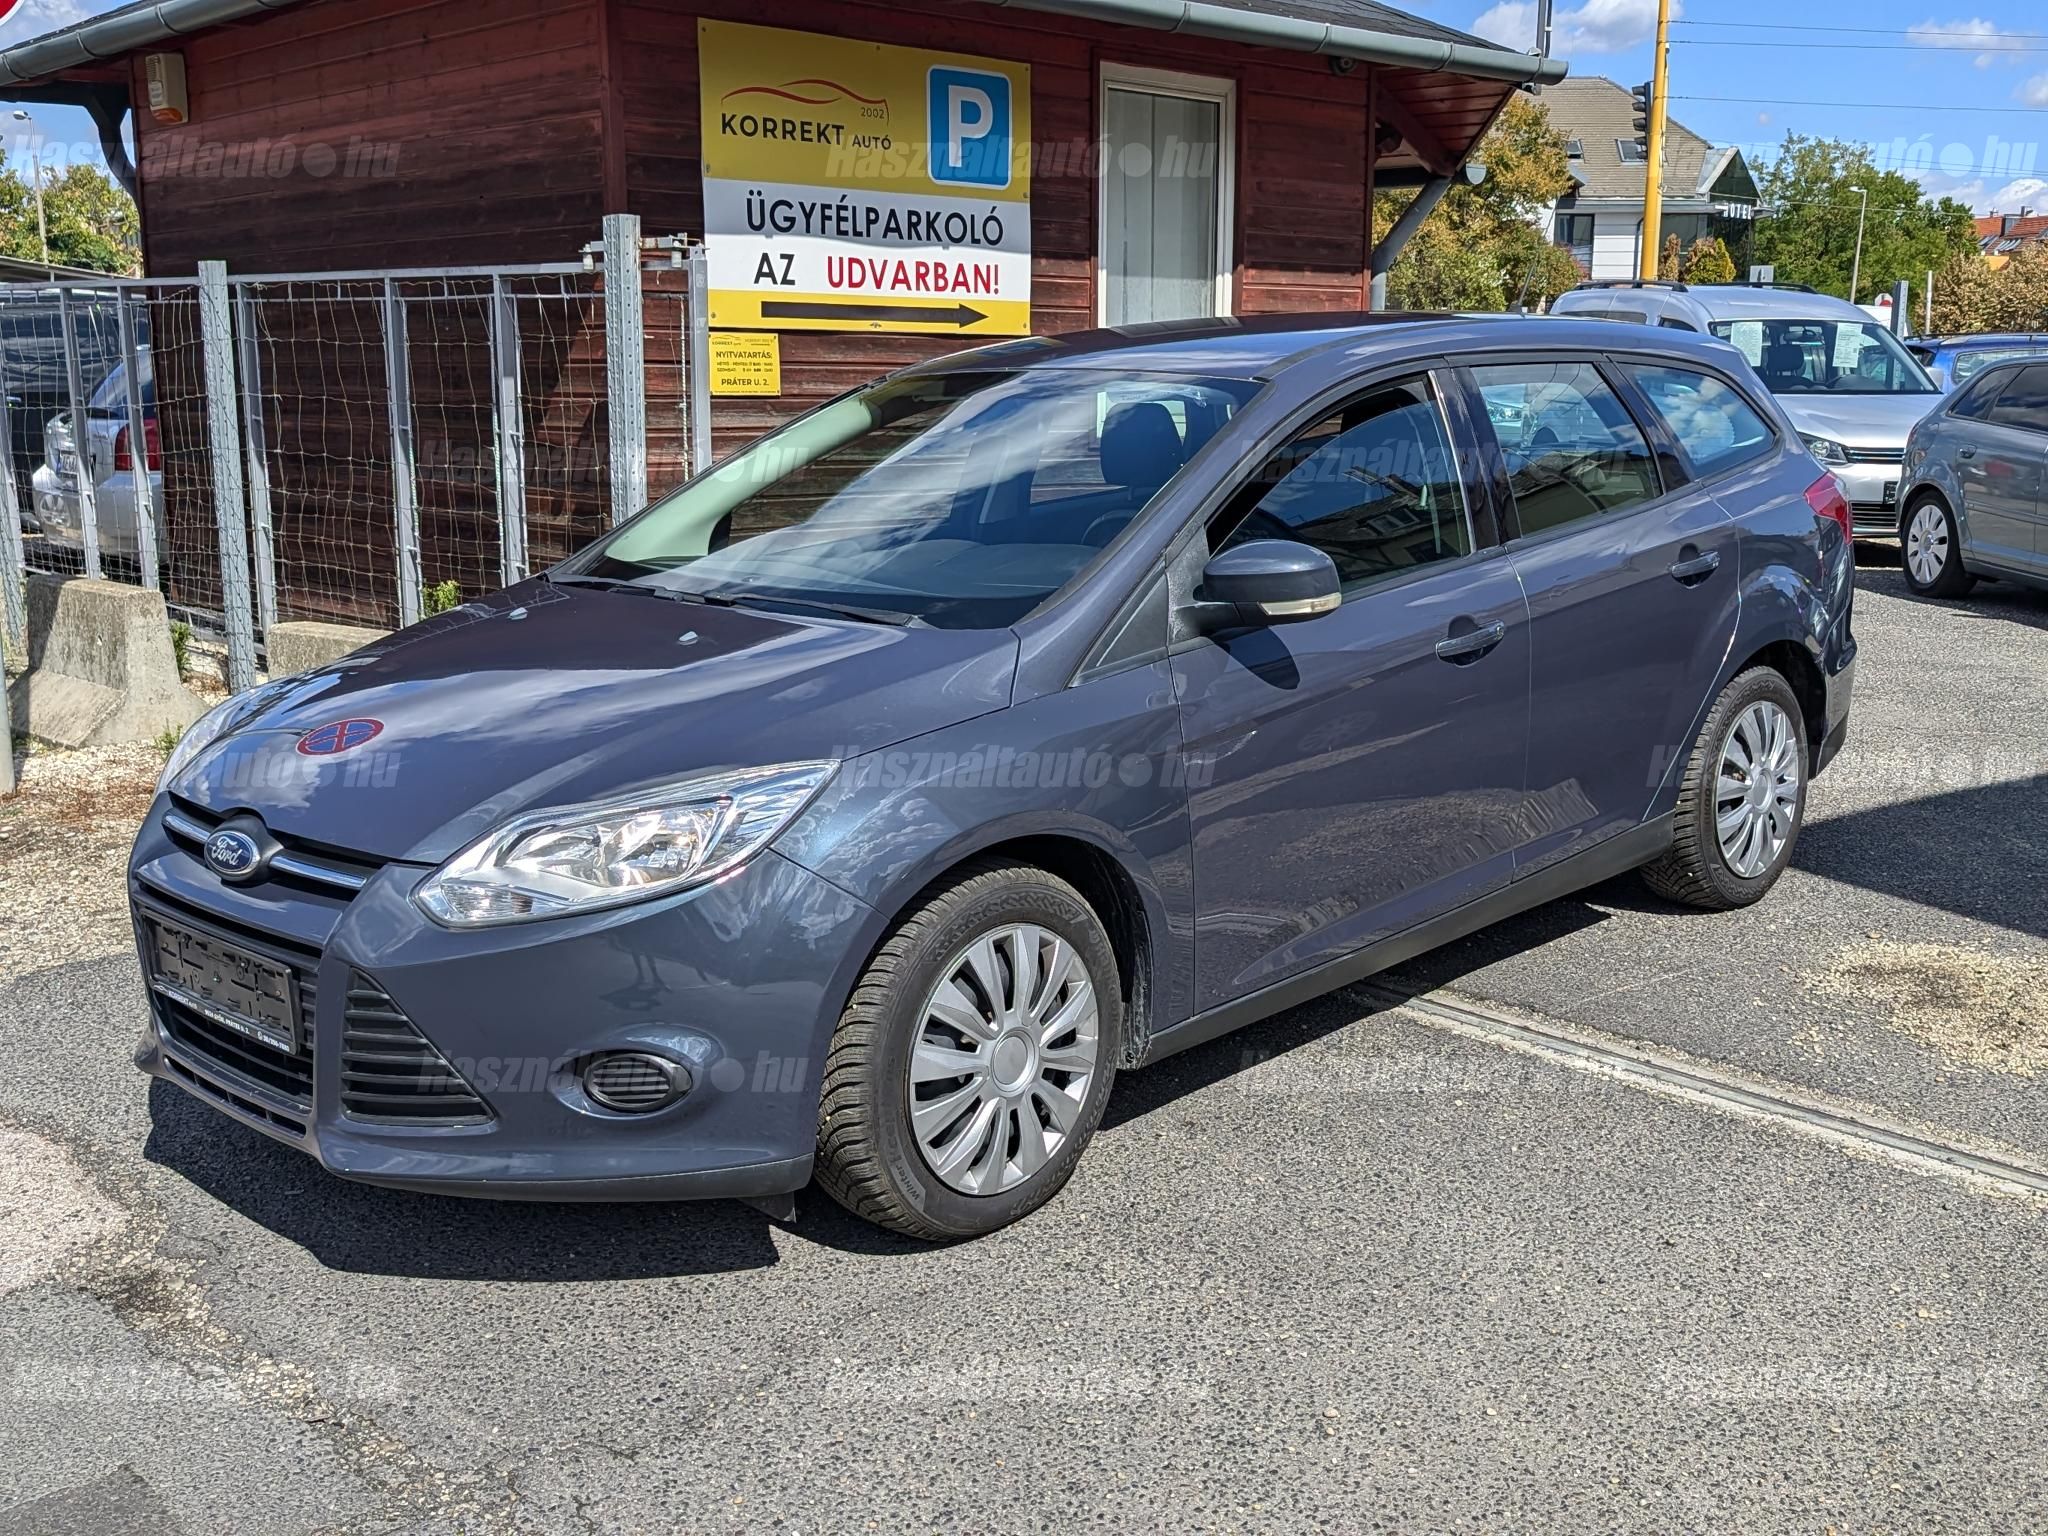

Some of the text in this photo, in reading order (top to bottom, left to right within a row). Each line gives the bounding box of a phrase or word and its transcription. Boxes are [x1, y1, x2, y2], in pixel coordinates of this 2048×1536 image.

[721, 113, 892, 150] KORREKT AUTÓ
[861, 107, 885, 119] 2002
[948, 85, 993, 167] P
[746, 190, 1004, 247] ÜGYFÉLPARKOLÓ
[754, 252, 1000, 295] AZ UDVARBAN!
[721, 377, 752, 386] PRÁTER
[211, 836, 243, 865] Ford
